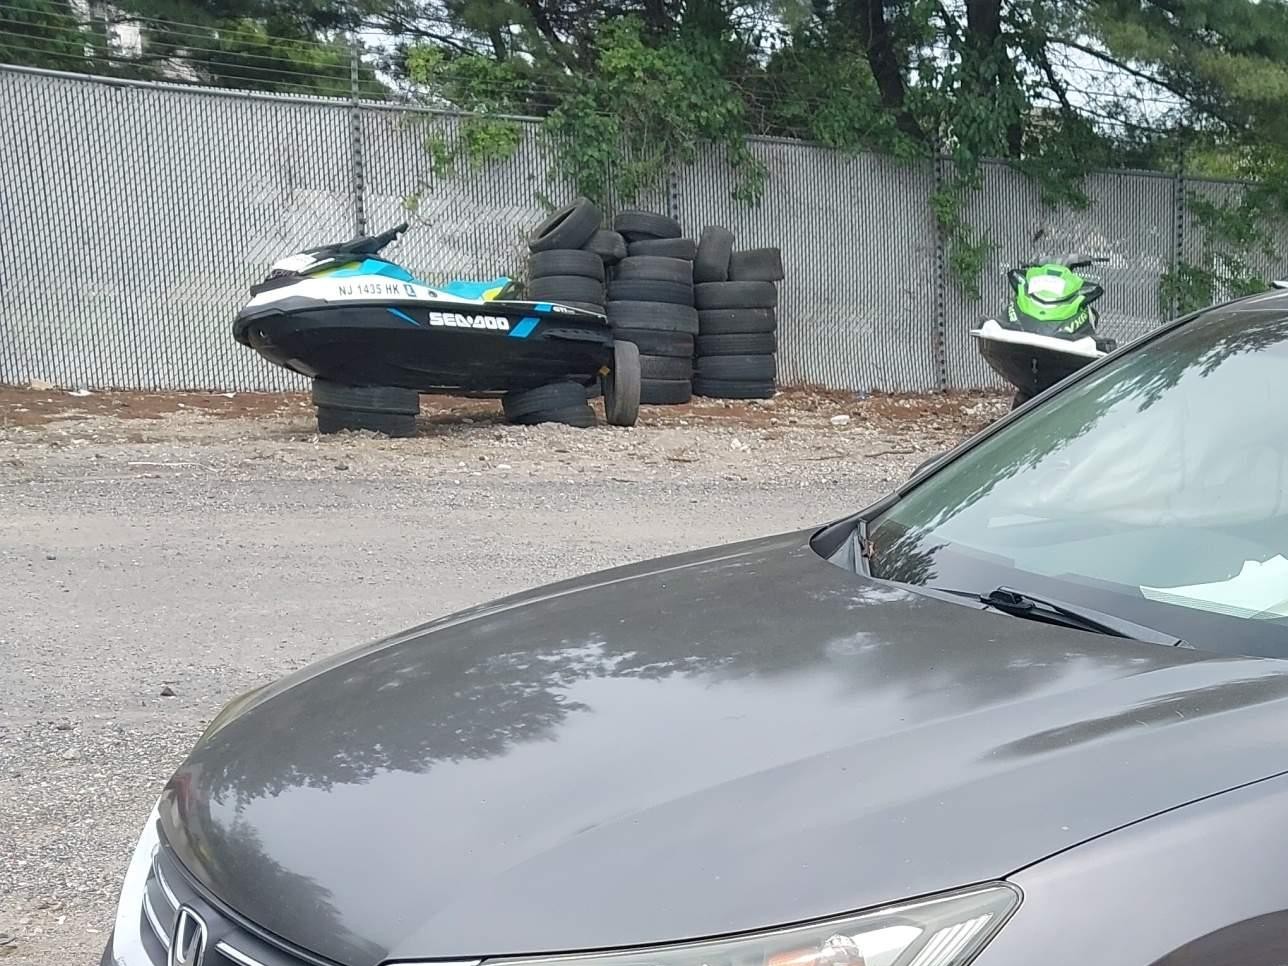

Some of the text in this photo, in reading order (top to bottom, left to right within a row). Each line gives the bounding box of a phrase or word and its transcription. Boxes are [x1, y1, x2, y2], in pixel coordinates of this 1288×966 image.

[338, 285, 353, 296] NJ
[357, 284, 382, 295] 1435
[385, 284, 399, 294] HK
